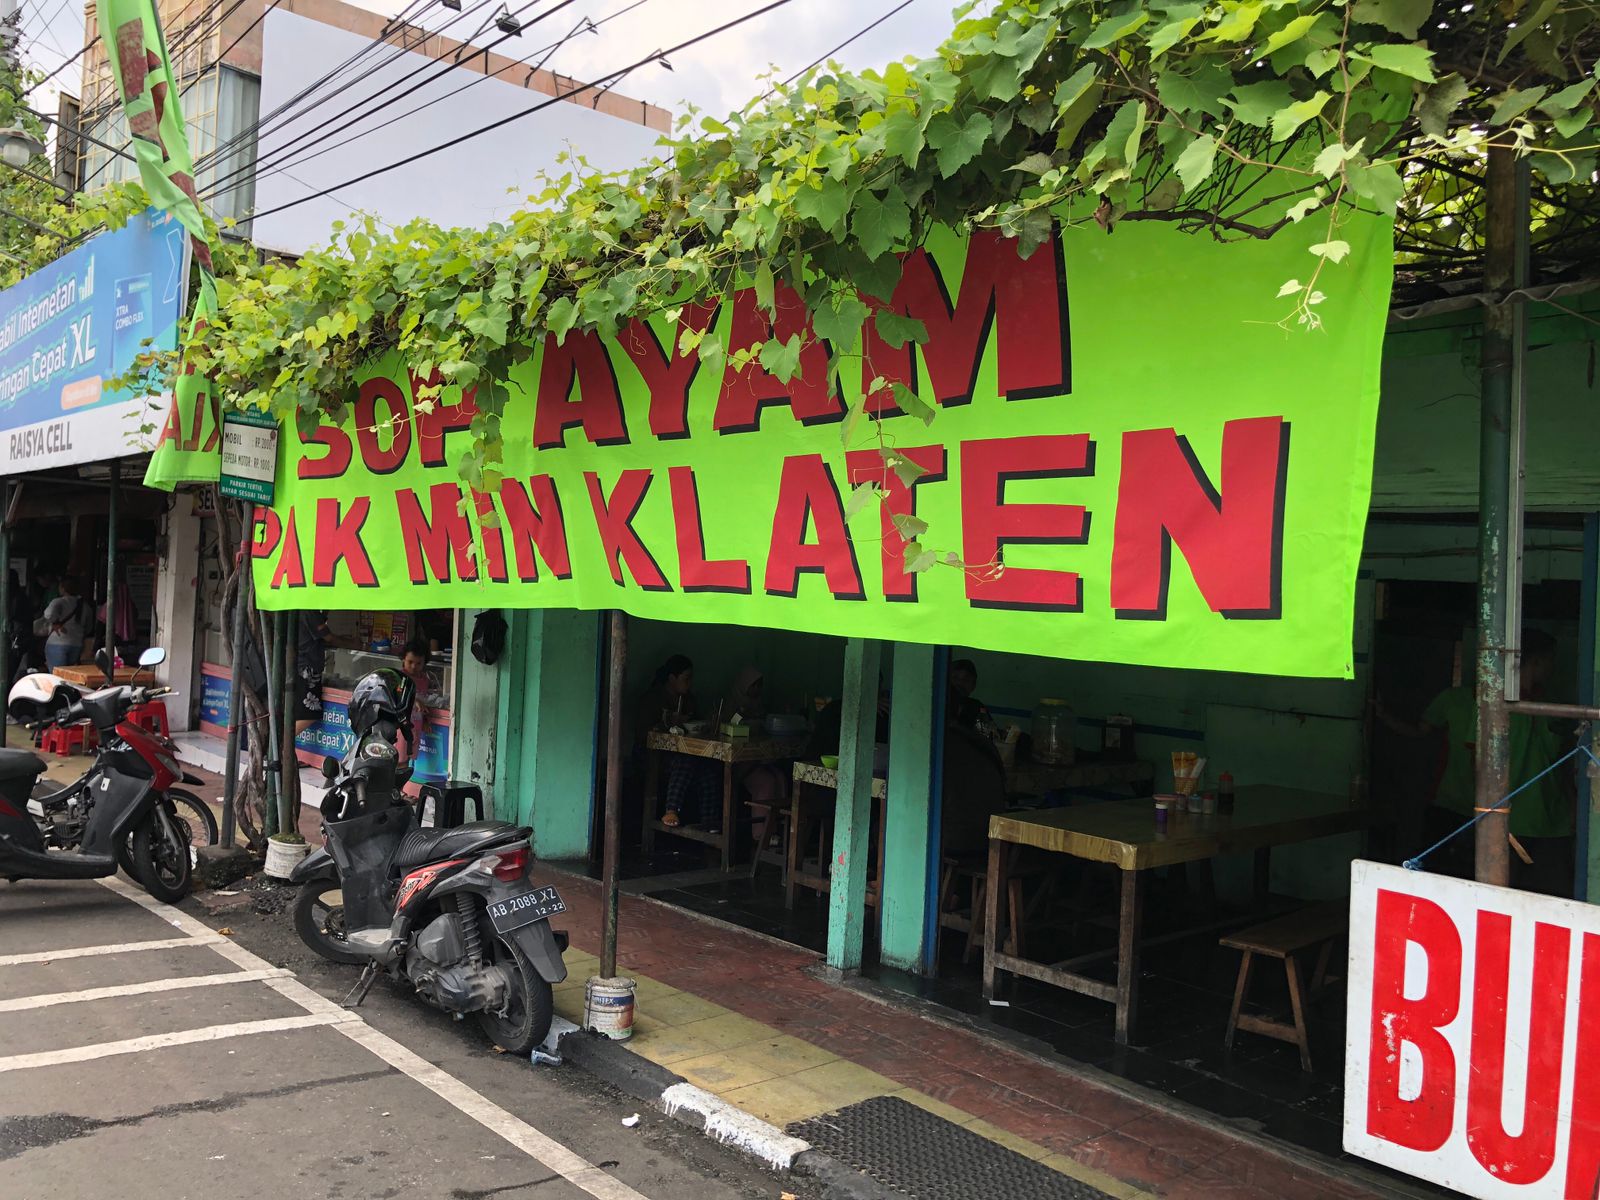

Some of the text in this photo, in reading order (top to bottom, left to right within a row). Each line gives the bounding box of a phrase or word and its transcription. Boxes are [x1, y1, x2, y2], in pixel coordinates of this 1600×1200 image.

[18, 278, 76, 338] Internetan
[32, 336, 67, 384] Cepat
[70, 313, 96, 369] XL
[295, 221, 1073, 480] SOP AYAM
[9, 421, 73, 461] RAISYA CELL
[225, 432, 242, 446] MOBIL
[221, 486, 271, 502] BAYAR SESUAI TARIF
[230, 480, 246, 488] PARKIR
[252, 415, 1291, 622] PAK MIN KLATEN
[317, 729, 340, 747] Cepat
[492, 887, 557, 919] AB 2088 XZ
